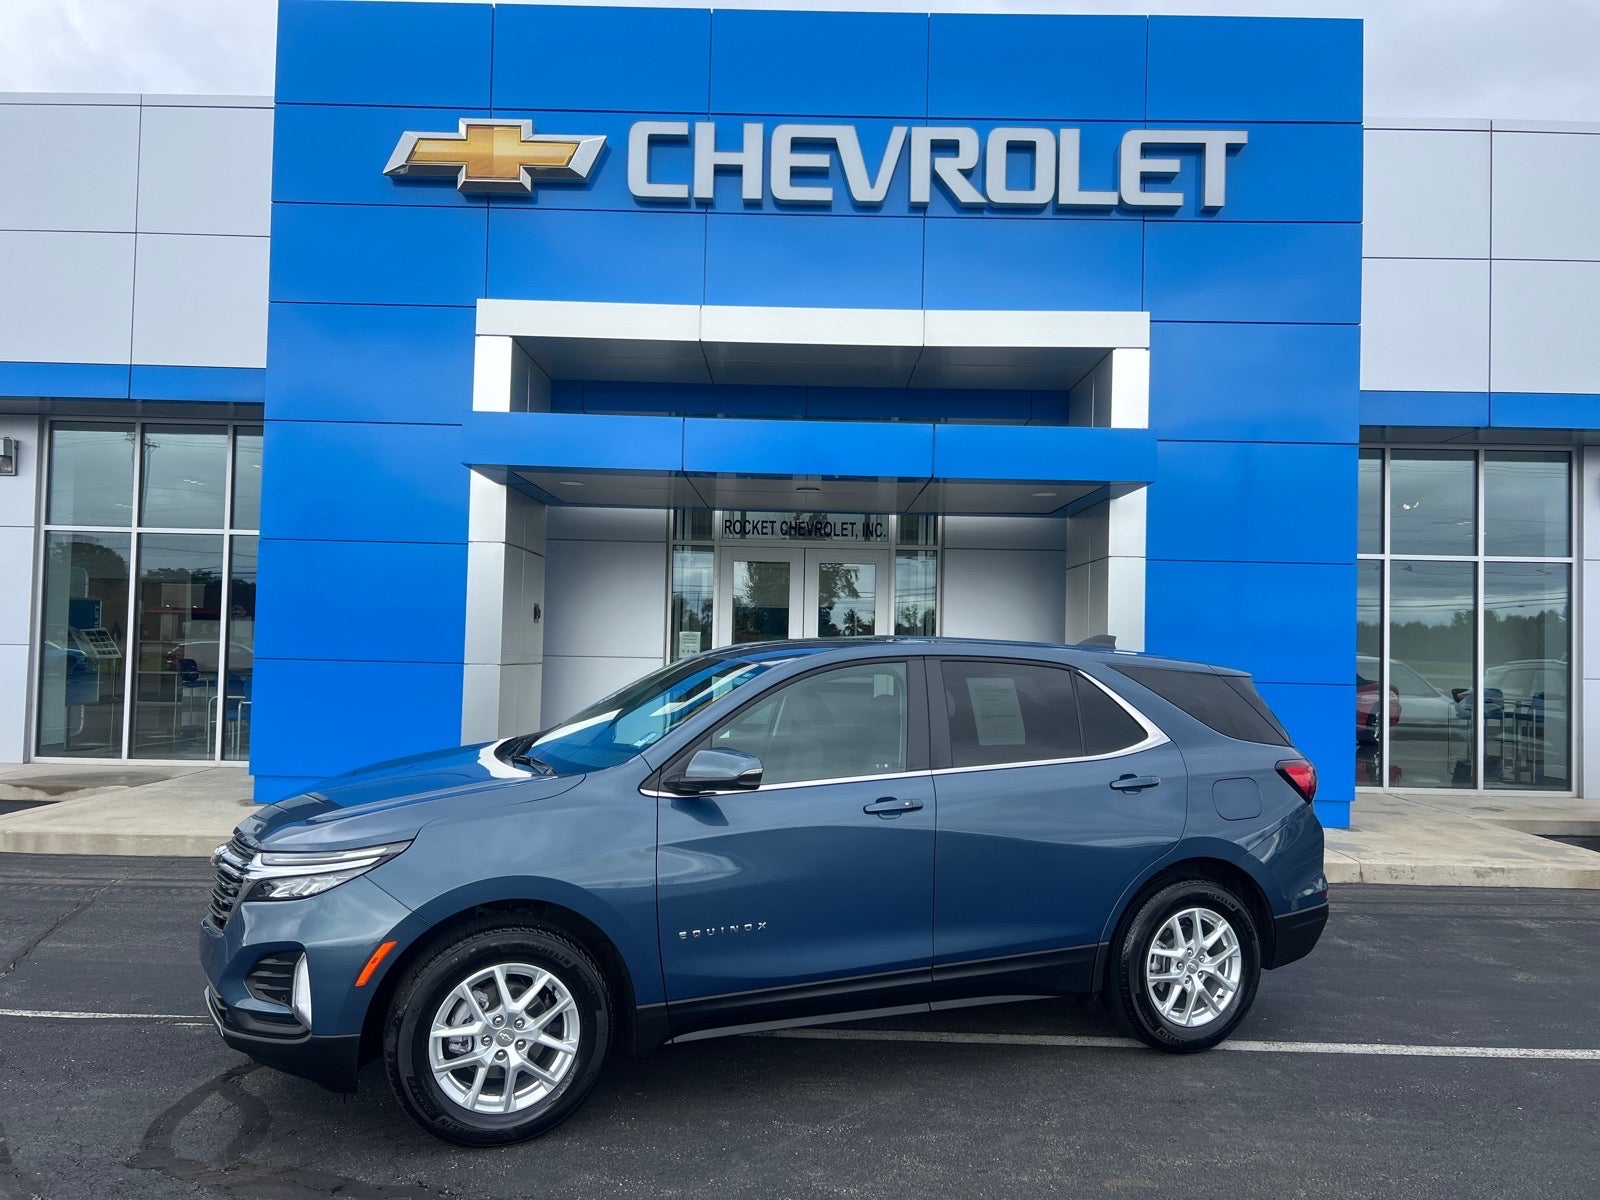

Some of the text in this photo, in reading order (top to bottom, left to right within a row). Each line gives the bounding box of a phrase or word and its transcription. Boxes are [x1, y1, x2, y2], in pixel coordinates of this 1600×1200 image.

[628, 120, 1249, 209] CHEVROLET
[724, 519, 777, 536] ROCKET
[862, 522, 887, 538] INC.
[679, 921, 767, 940] EQUINOX
